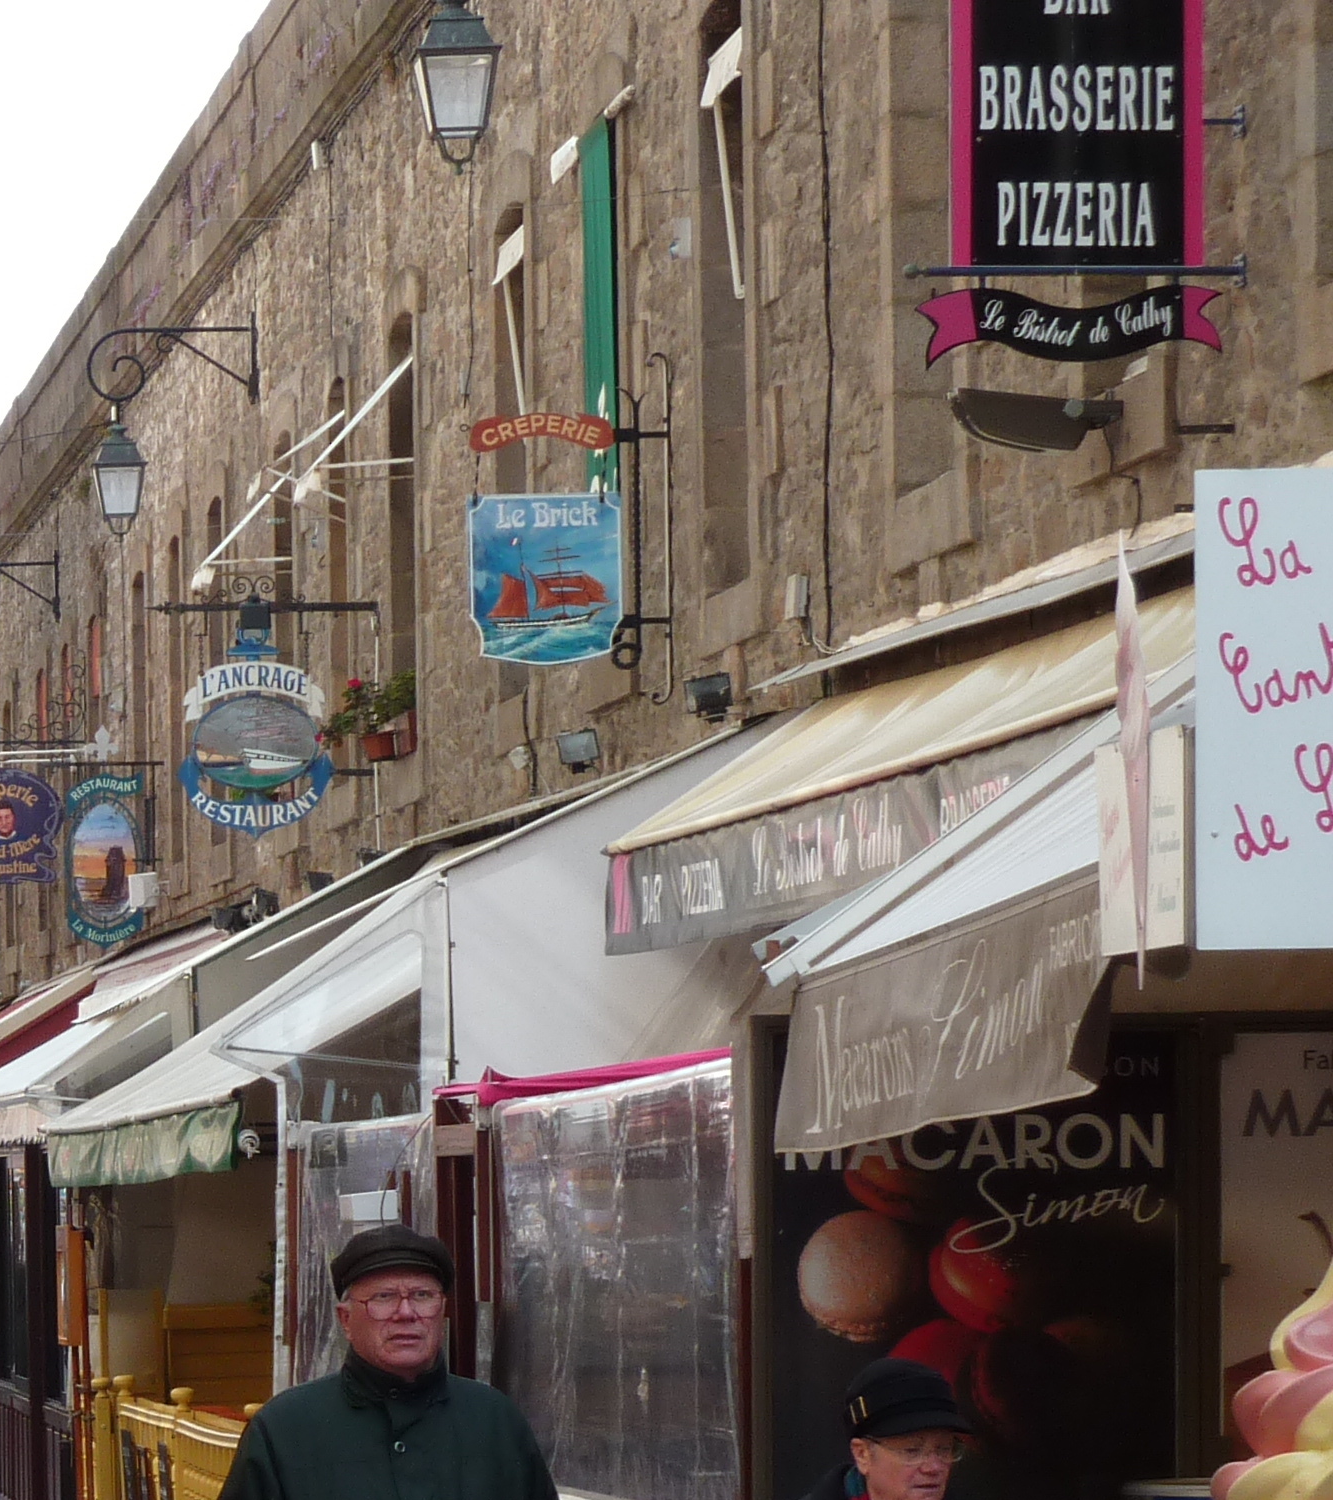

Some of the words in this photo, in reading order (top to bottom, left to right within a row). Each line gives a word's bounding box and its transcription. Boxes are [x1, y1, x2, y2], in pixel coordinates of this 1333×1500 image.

[979, 65, 1175, 132] BRASSERIE
[997, 180, 1156, 248] PIZZERIA
[980, 299, 1004, 331] Le
[1013, 308, 1081, 347] Bistrot
[1089, 314, 1109, 345] de
[1114, 295, 1173, 336] Cathy
[481, 414, 602, 446] CREPERIE
[496, 502, 526, 529] Le
[530, 499, 599, 529] Brick
[1217, 496, 1313, 588] La
[200, 664, 309, 699] L'ANCRAGE
[71, 778, 139, 801] RESTAURANT
[191, 787, 320, 828] RESTAURANT
[1234, 803, 1290, 863] de
[641, 873, 663, 925] BAR
[680, 857, 724, 917] PIZZERIA
[949, 1150, 1166, 1255] Simon
